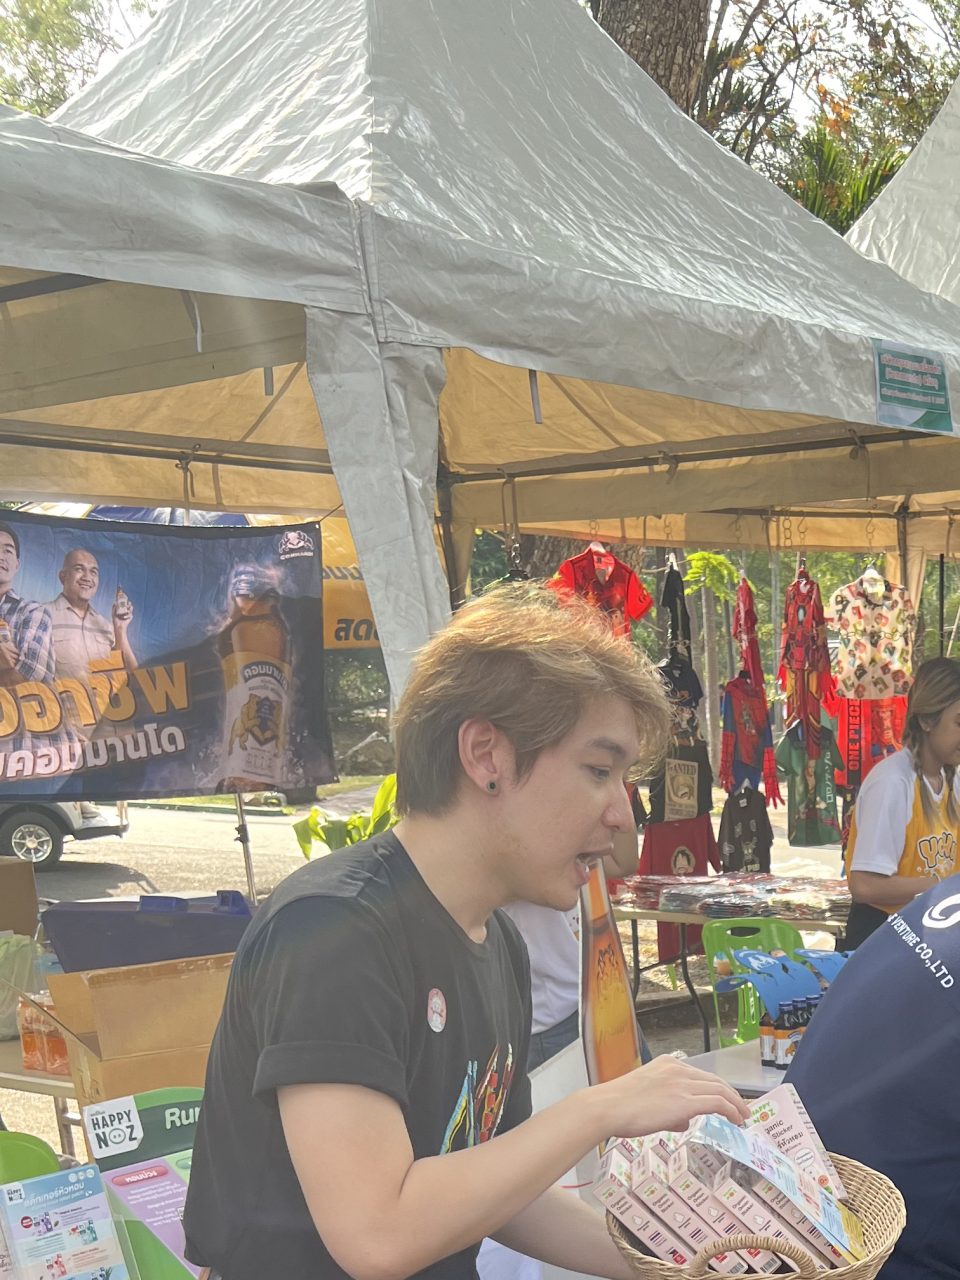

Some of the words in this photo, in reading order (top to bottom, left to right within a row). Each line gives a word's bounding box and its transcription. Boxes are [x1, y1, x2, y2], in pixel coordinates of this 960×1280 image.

[0, 722, 186, 778] คอมมานโด
[890, 915, 921, 947] VENTURE
[91, 1110, 132, 1131] HAPPY
